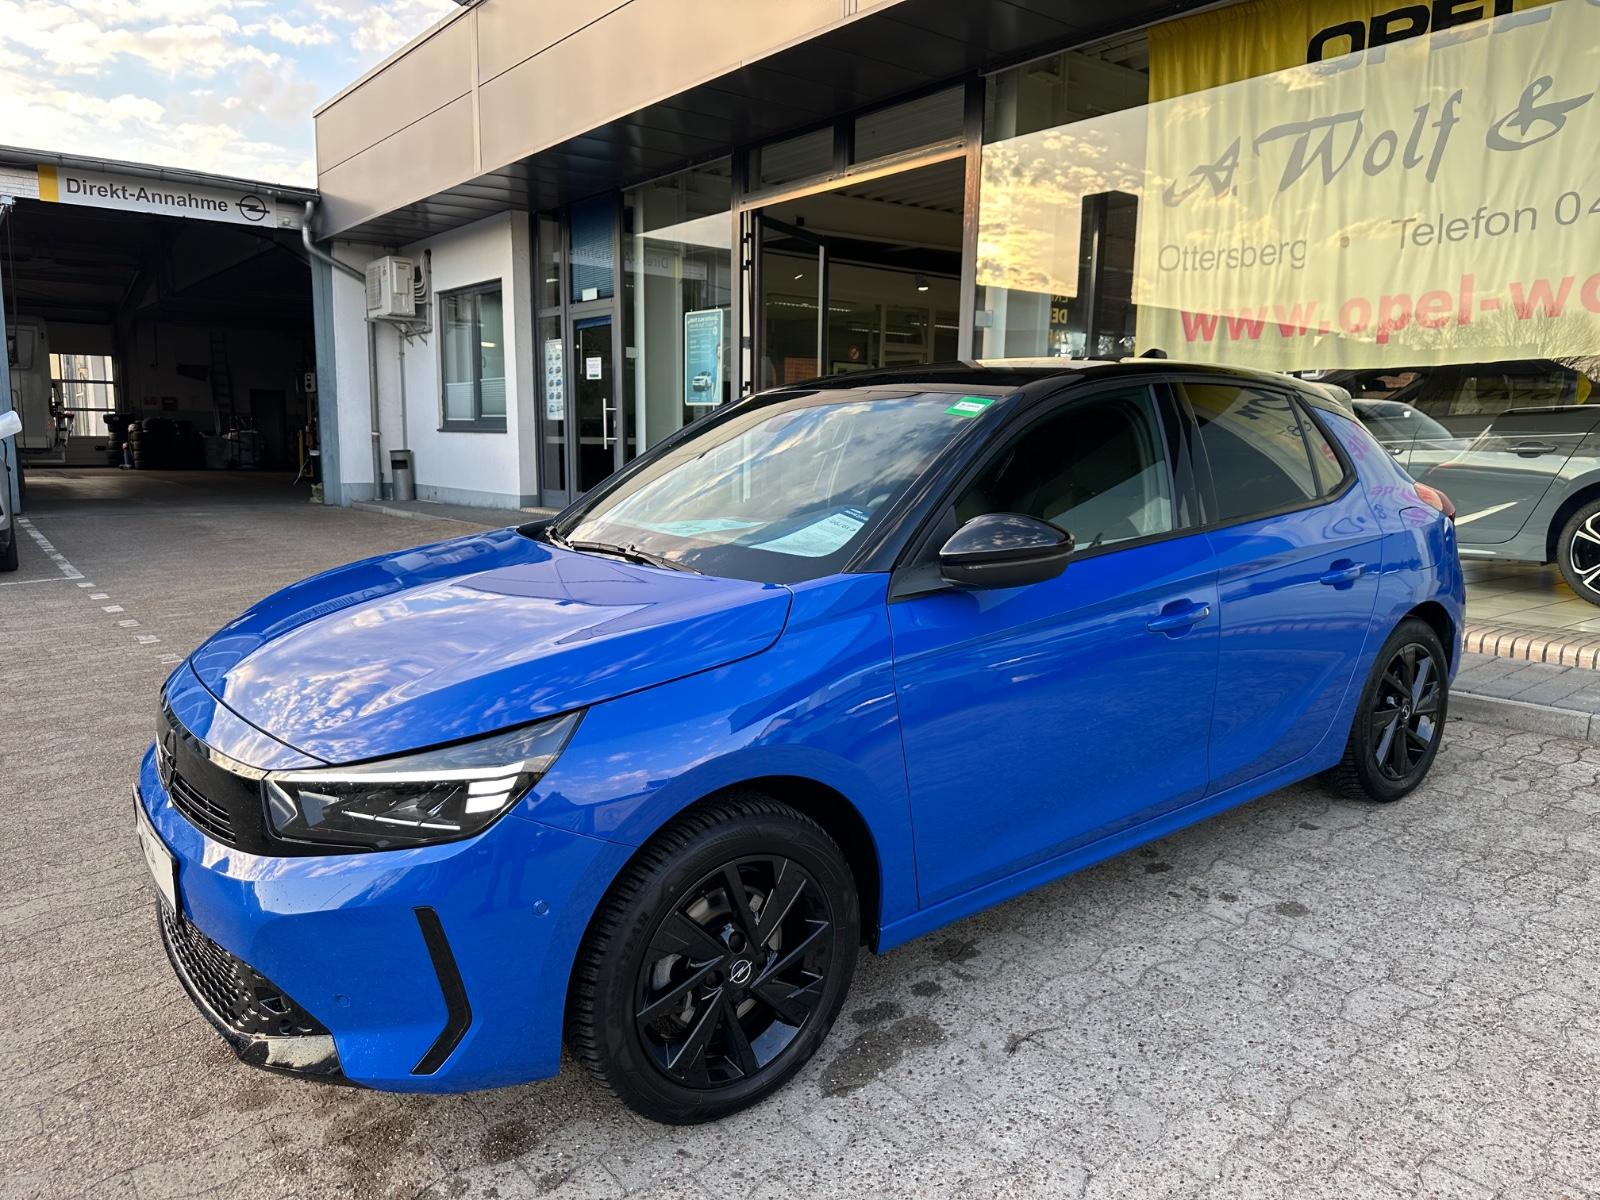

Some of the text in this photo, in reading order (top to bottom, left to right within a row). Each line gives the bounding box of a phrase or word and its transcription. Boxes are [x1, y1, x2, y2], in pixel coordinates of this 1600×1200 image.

[1307, 0, 1552, 75] OPEL
[1162, 75, 1595, 208] A. Wolf &
[66, 178, 228, 212] Direkt-Annahme
[1157, 238, 1307, 273] Ottersberg
[1391, 205, 1537, 250] Telefon
